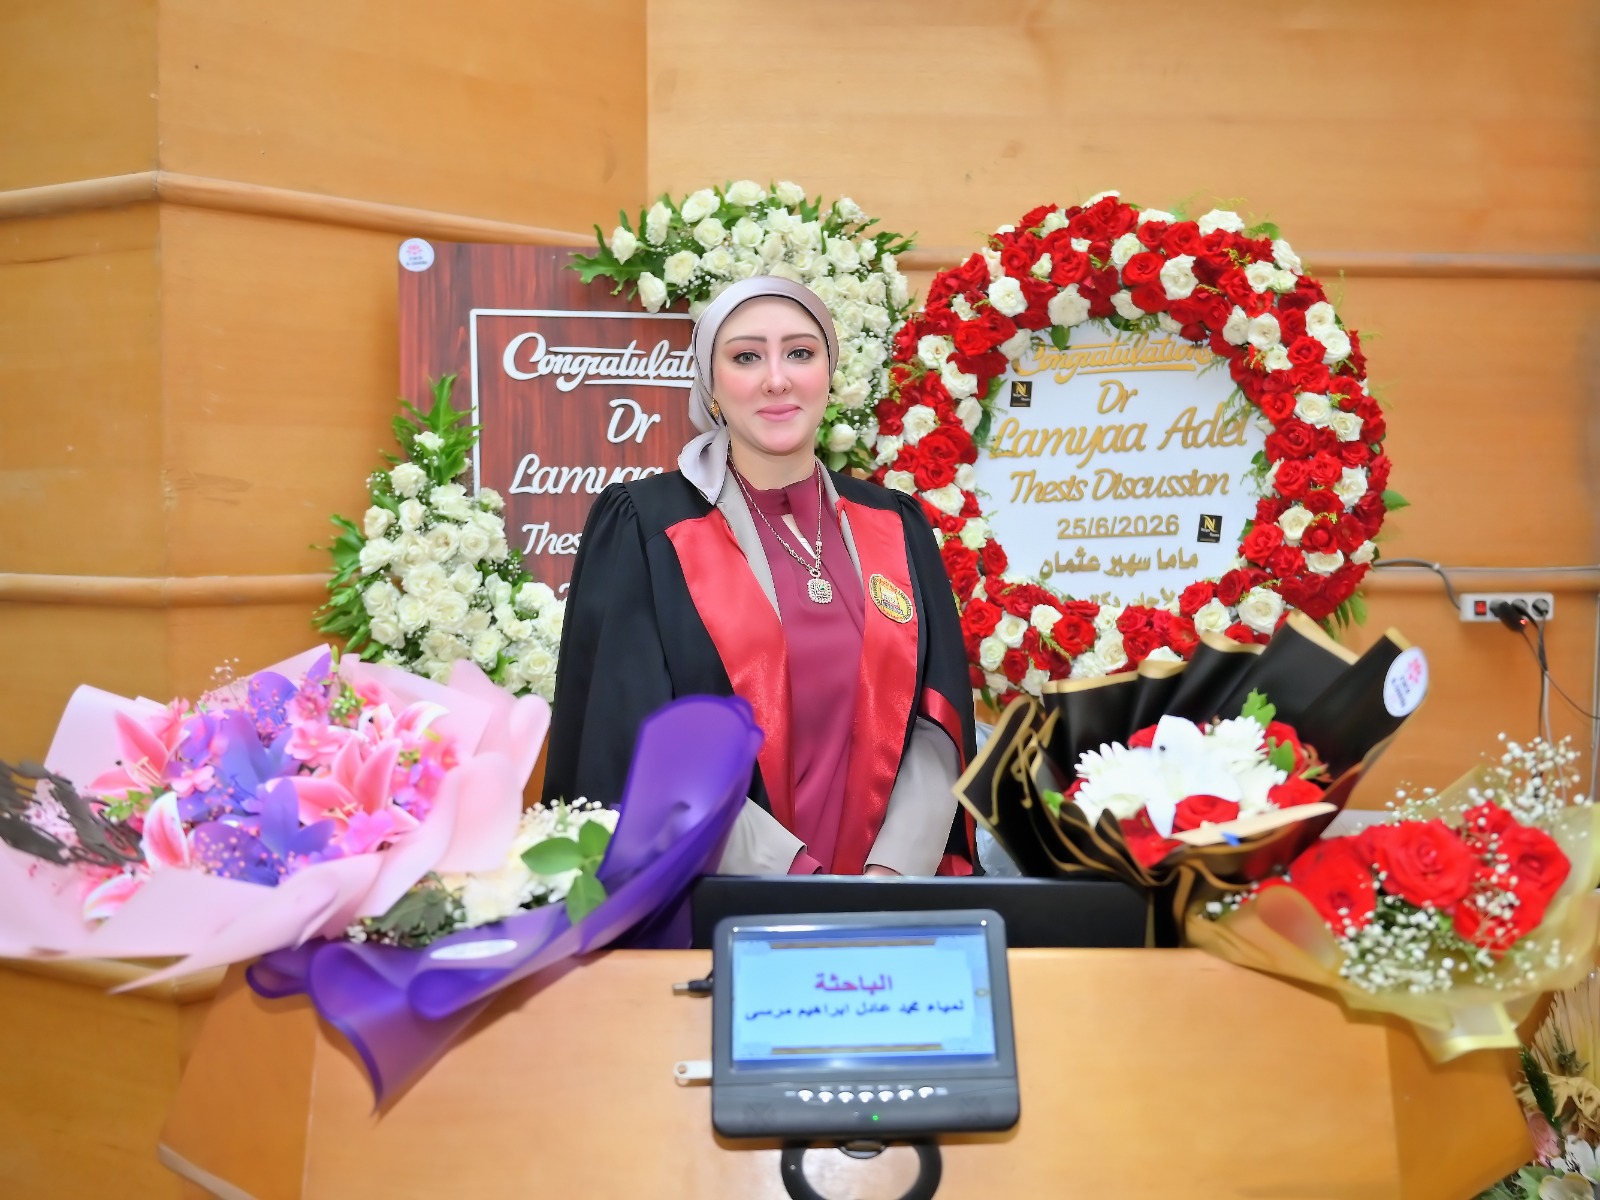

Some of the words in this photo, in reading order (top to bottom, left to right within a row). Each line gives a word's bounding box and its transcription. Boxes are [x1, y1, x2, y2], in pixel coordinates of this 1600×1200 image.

[503, 332, 696, 392] Congratulat
[1011, 335, 1213, 384] Congratulations
[1097, 379, 1138, 414] Dr
[606, 398, 661, 444] Dr
[988, 417, 1148, 468] Lamyaa
[1156, 401, 1248, 451] Adel
[1009, 469, 1088, 503] Thesis
[1091, 468, 1230, 501] Discussion
[1057, 514, 1180, 539] 25/6/2026
[1039, 545, 1101, 579] عثمان
[1103, 553, 1151, 577] سهير
[1156, 546, 1199, 570] ماما
[815, 973, 893, 995] الباحثة
[856, 1002, 890, 1016] عادل
